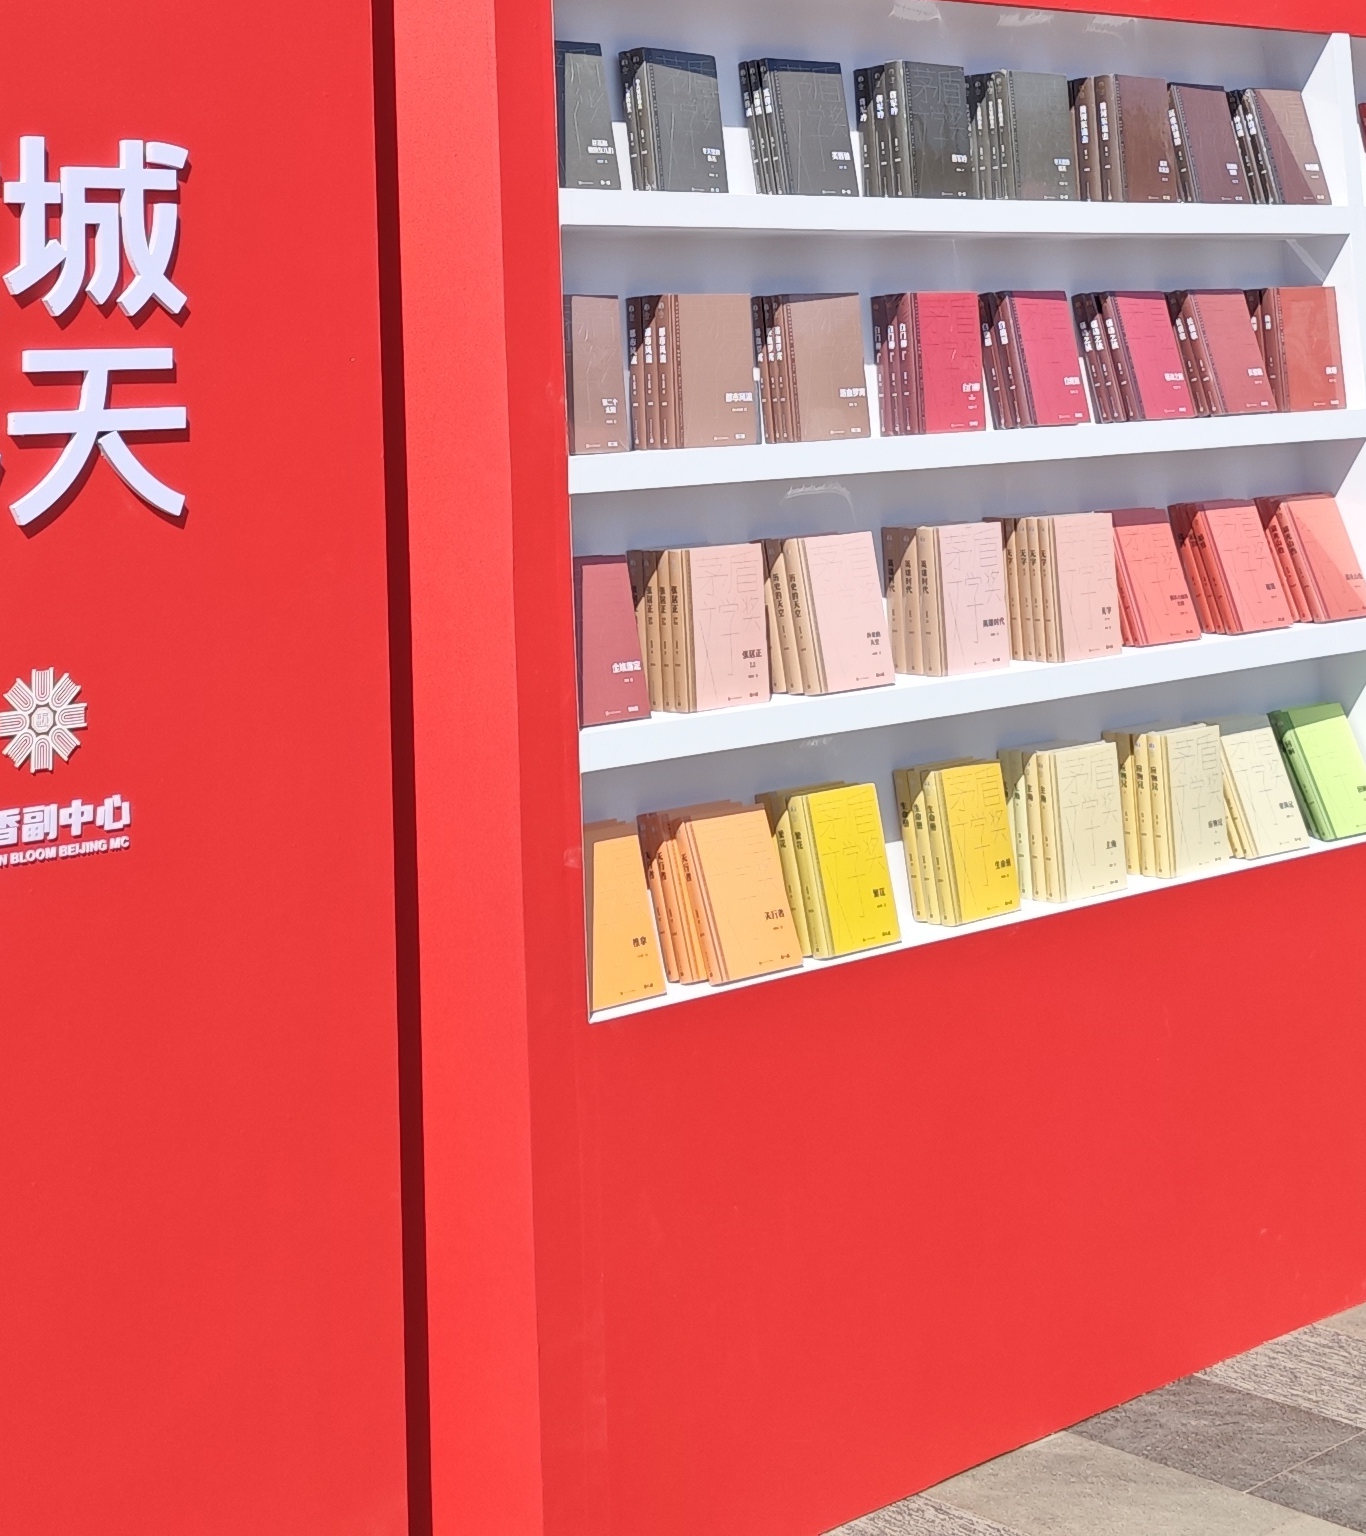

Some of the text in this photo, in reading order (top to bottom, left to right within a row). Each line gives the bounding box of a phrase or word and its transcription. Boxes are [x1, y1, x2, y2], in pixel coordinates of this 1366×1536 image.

[772, 572, 785, 618] 历史的天空
[788, 573, 802, 618] 历史的天空
[9, 846, 57, 865] BLOOM
[58, 839, 108, 857] BEIJING
[109, 835, 130, 850] MC
